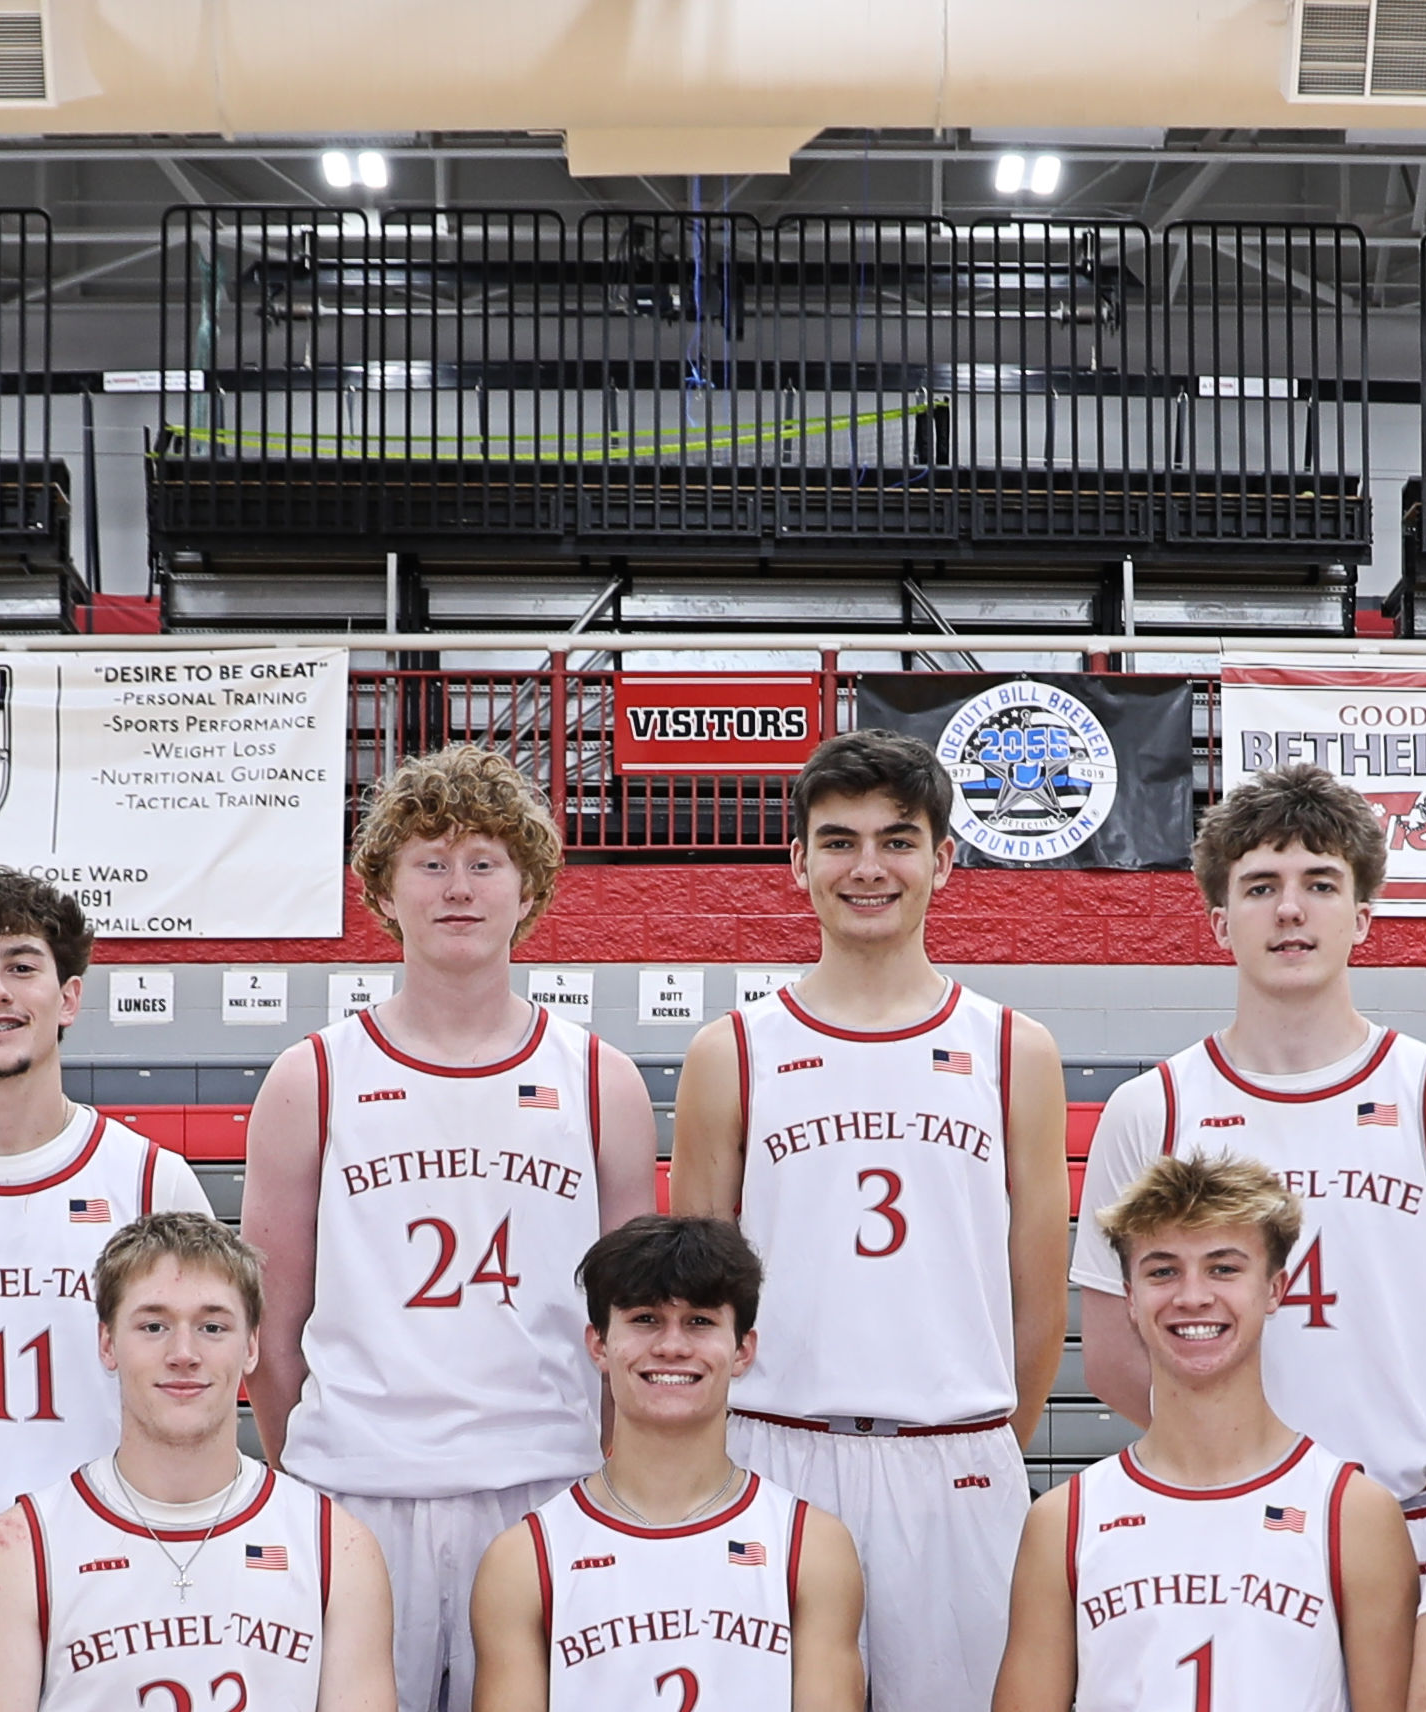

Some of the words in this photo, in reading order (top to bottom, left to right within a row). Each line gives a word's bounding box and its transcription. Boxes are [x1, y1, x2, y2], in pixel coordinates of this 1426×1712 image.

[184, 665, 212, 682] TO
[219, 664, 243, 680] BE
[628, 707, 807, 741] VISITORS
[941, 697, 994, 759] DEPUTY
[999, 686, 1040, 706] BILL
[1048, 692, 1110, 758] BREWER
[978, 728, 1072, 761] 2055
[1080, 769, 1105, 779] 2019
[961, 816, 1094, 857] FOUNDATION
[117, 999, 167, 1012] LUNGES
[532, 993, 556, 1003] HIGH
[559, 994, 589, 1005] KNEES
[651, 1007, 691, 1018] KICKERS
[659, 992, 683, 1002] BUTT
[763, 1111, 992, 1166] BETHEL-TATE
[341, 1147, 583, 1200] BETHEL-TATE
[854, 1167, 908, 1258] 3
[403, 1207, 520, 1312] 24
[1080, 1572, 1325, 1630] BETHEL-TATE
[65, 1612, 315, 1674] BETHEL-TATE
[556, 1607, 791, 1669] BETHEL-TATE
